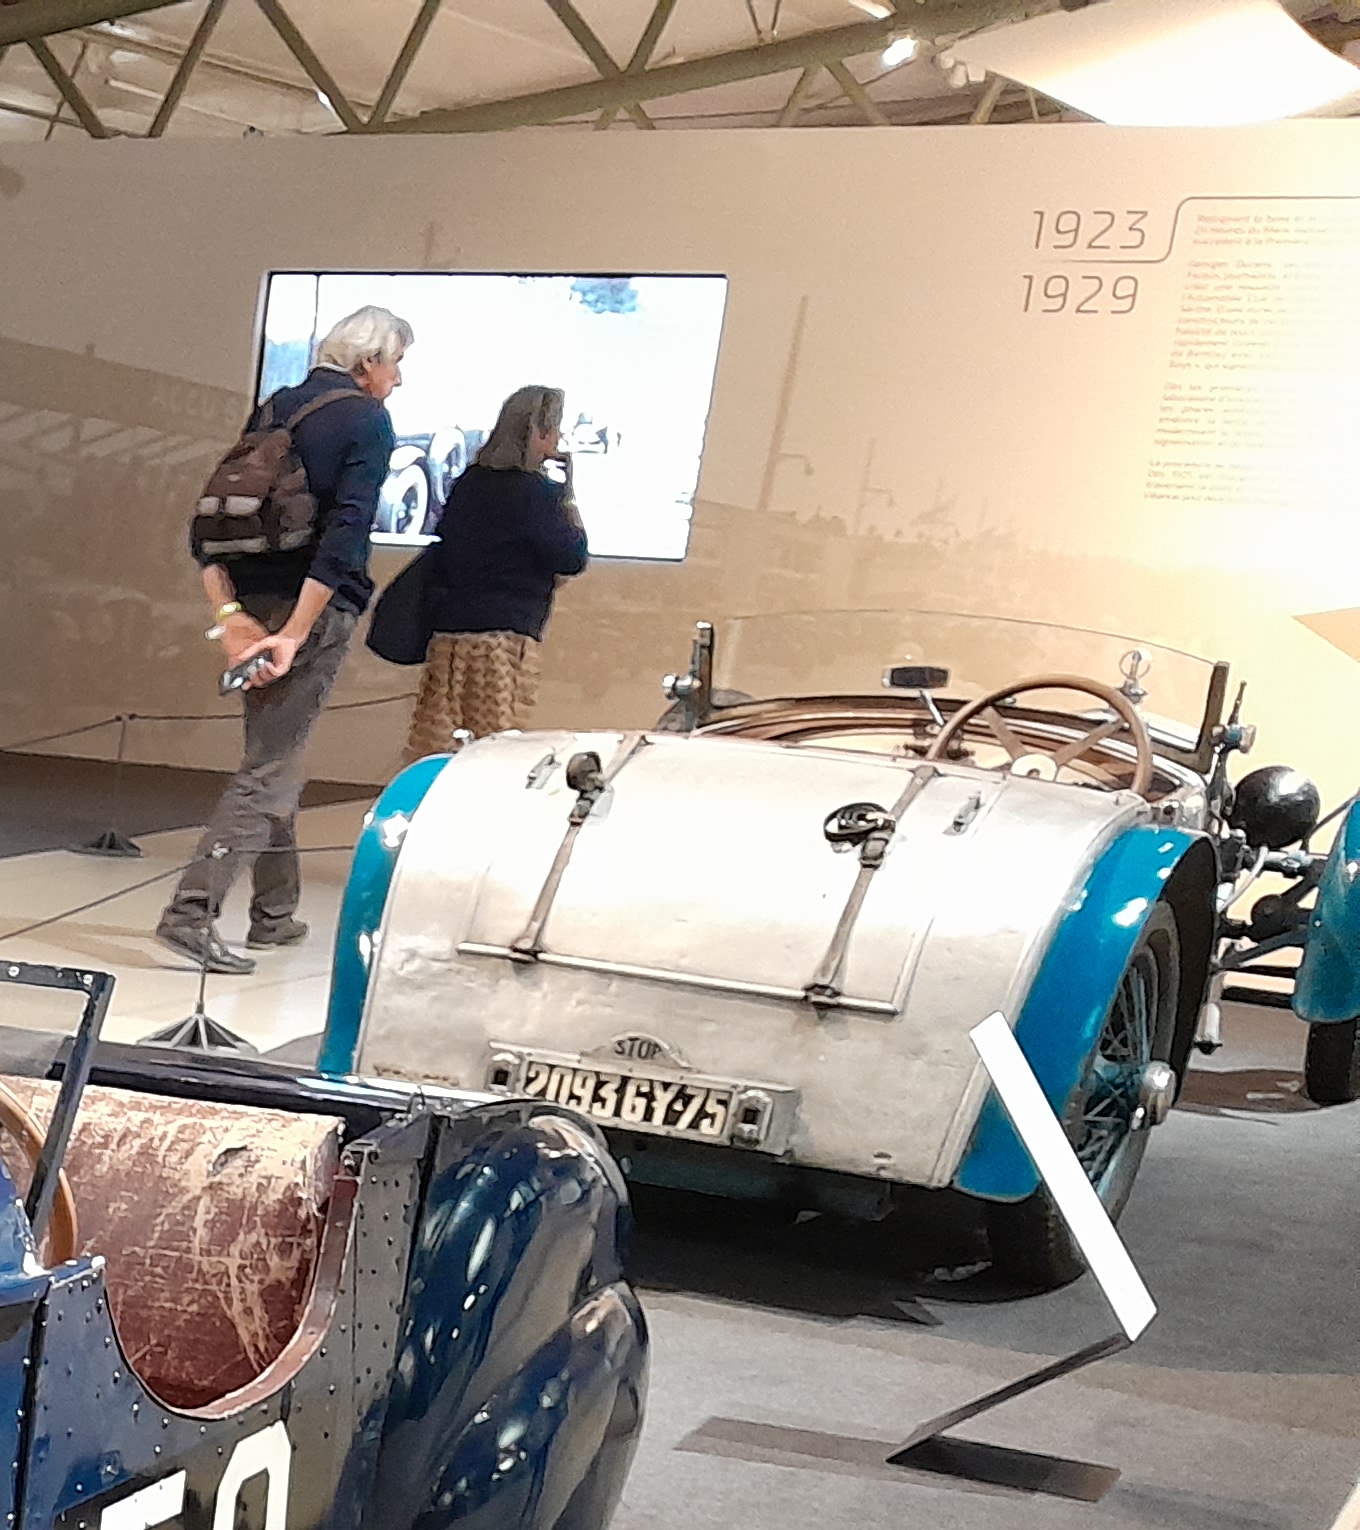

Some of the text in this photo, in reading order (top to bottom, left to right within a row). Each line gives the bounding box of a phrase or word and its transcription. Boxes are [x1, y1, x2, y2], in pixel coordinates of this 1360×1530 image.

[1032, 210, 1149, 250] 1923
[1022, 274, 1140, 315] 1929
[614, 1036, 663, 1060] STOP
